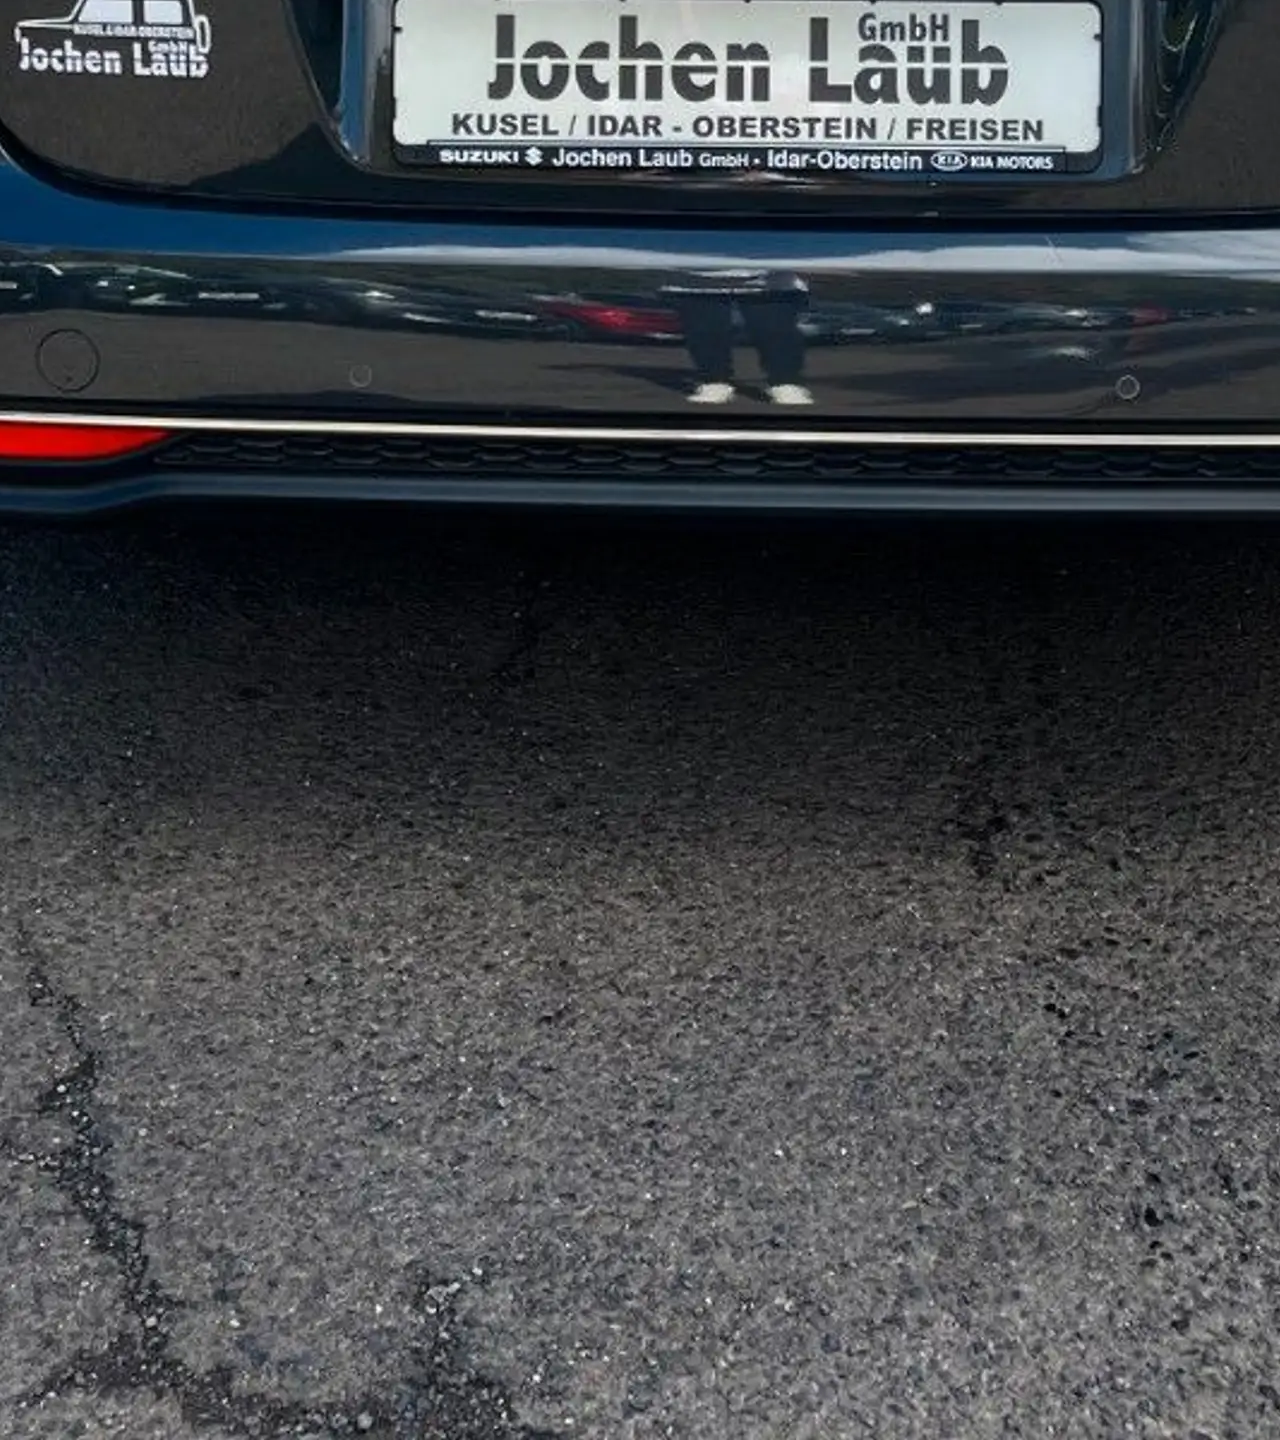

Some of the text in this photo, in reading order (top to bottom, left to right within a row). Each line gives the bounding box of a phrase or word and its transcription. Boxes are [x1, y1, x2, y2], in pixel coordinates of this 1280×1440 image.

[858, 13, 950, 42] GmbH
[19, 37, 210, 79] Jochen Laub
[487, 14, 1008, 106] Jochen Laub
[452, 113, 559, 137] KUSEL
[587, 114, 663, 138] IDAR
[692, 114, 877, 140] OBERSTEIN
[906, 118, 1044, 142] FREISEN
[439, 149, 520, 164] SUZUKI
[551, 148, 633, 168] Jochen
[638, 148, 694, 168] Laub
[699, 152, 750, 169] GmbH
[768, 149, 923, 172] Idar-Oberstein
[971, 154, 993, 170] KIA
[996, 155, 1054, 171] MOTORS
